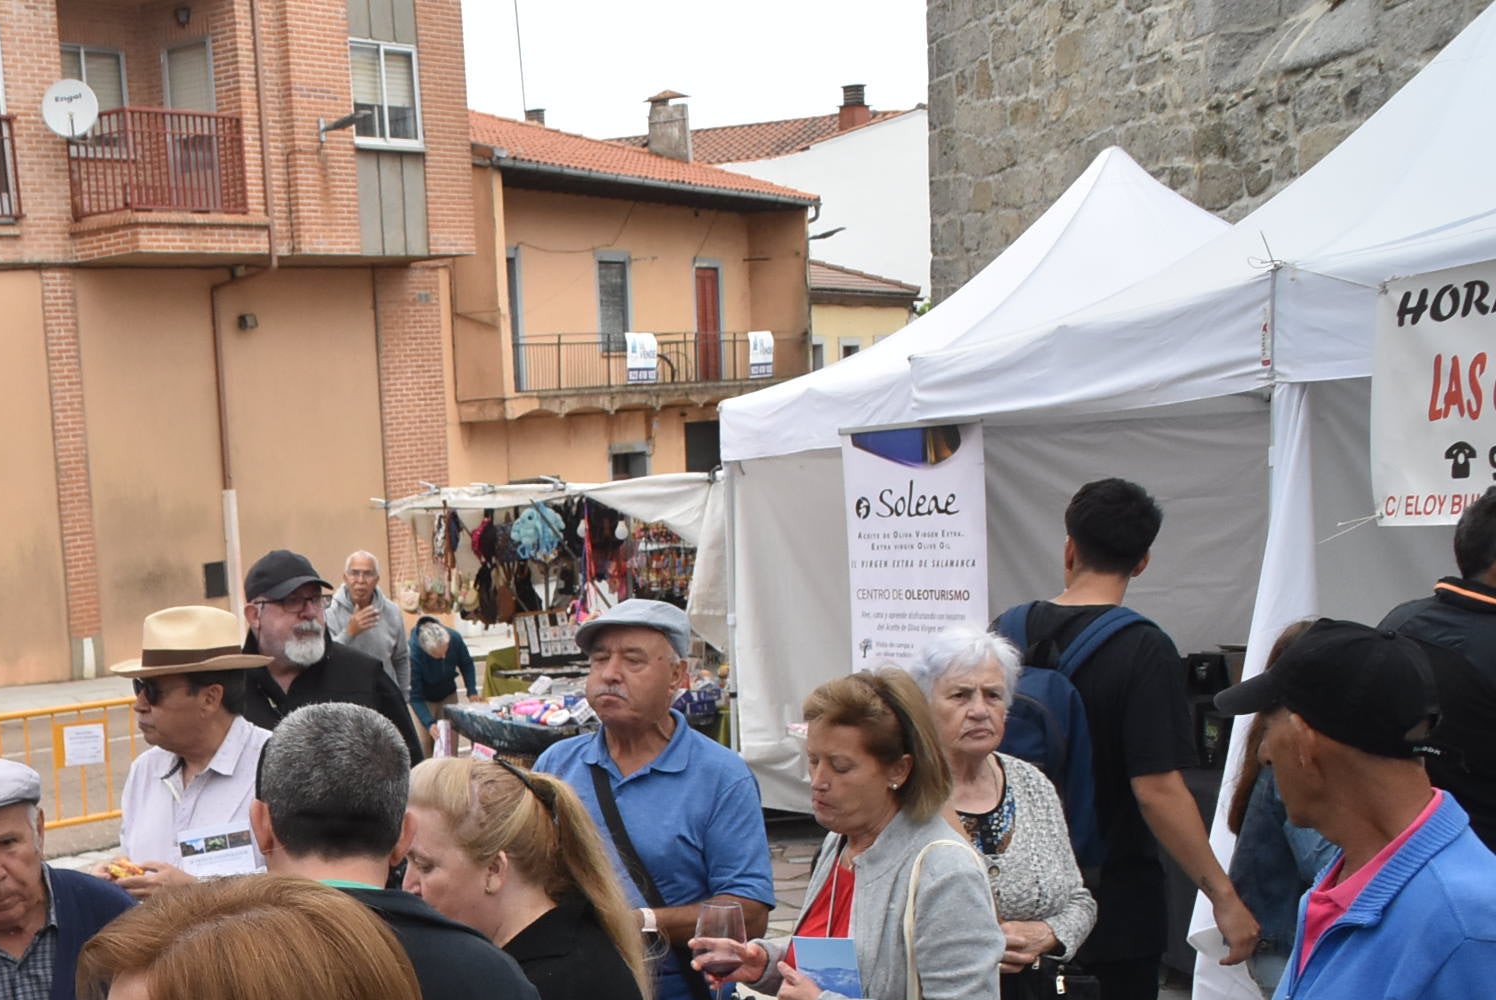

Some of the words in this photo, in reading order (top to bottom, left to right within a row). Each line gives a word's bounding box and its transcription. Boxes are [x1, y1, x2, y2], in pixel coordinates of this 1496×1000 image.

[1397, 279, 1496, 328] HOR
[1428, 352, 1488, 421] LAS
[875, 479, 960, 518] Soleae
[1385, 495, 1402, 518] C/
[1404, 494, 1447, 515] ELOY
[856, 588, 890, 600] CENTRO
[892, 589, 903, 600] DE
[904, 589, 970, 601] OLEOTURISMO
